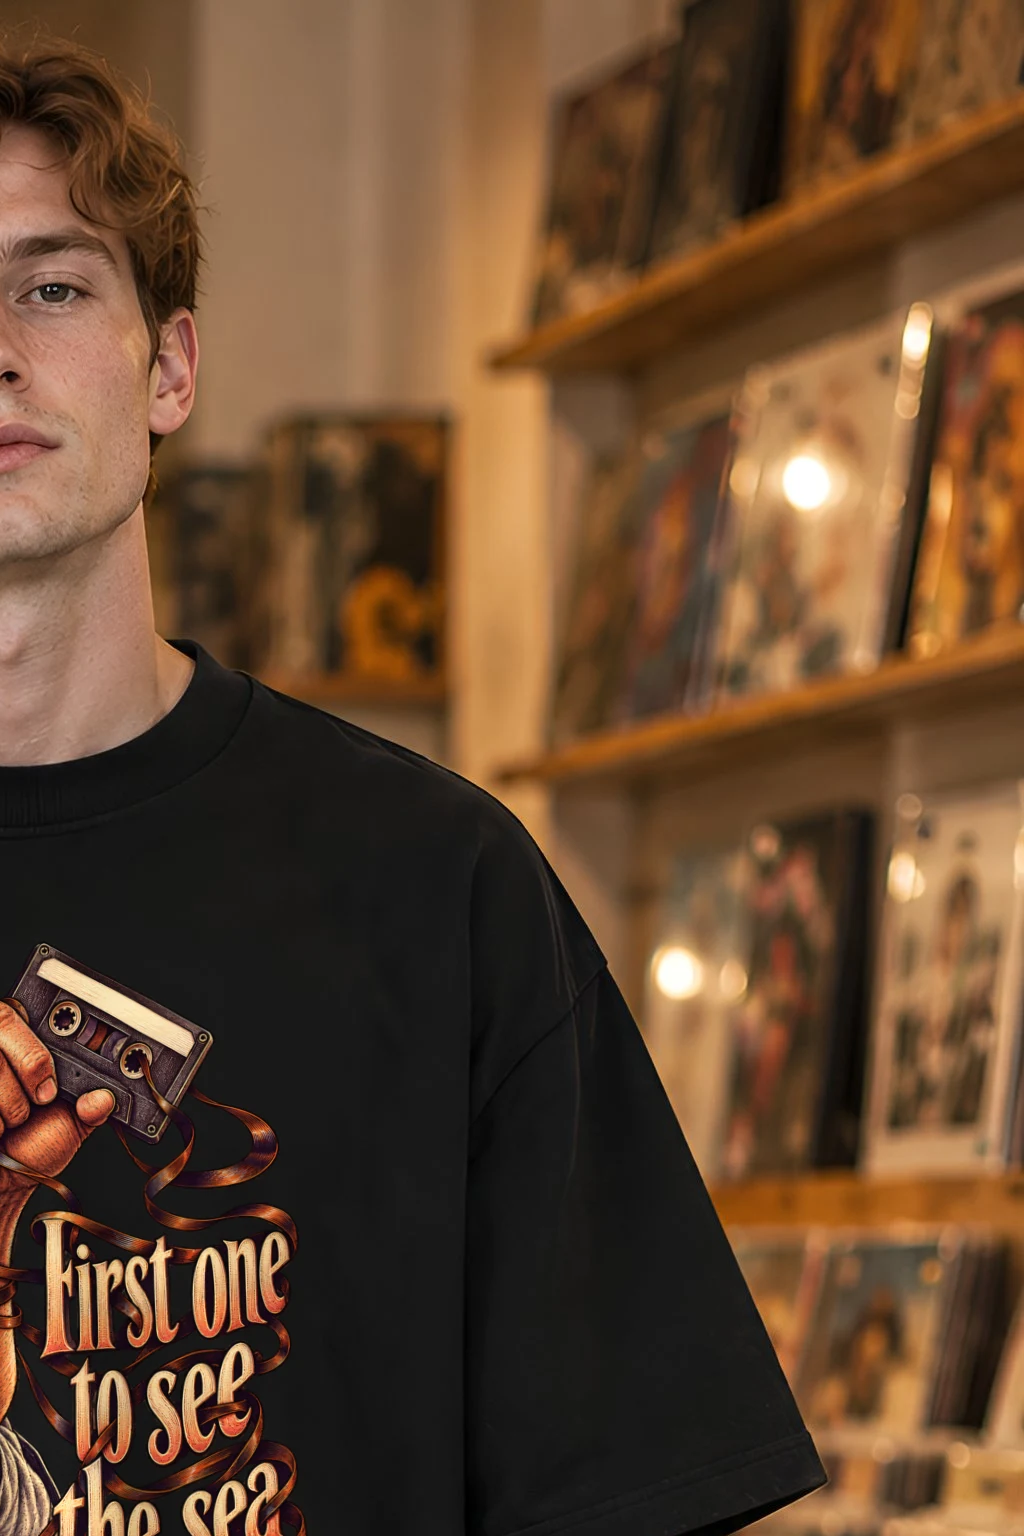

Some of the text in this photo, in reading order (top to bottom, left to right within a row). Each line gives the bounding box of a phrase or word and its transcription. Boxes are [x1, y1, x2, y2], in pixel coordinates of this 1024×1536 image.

[40, 1218, 291, 1359] First one
[70, 1342, 255, 1466] to see
